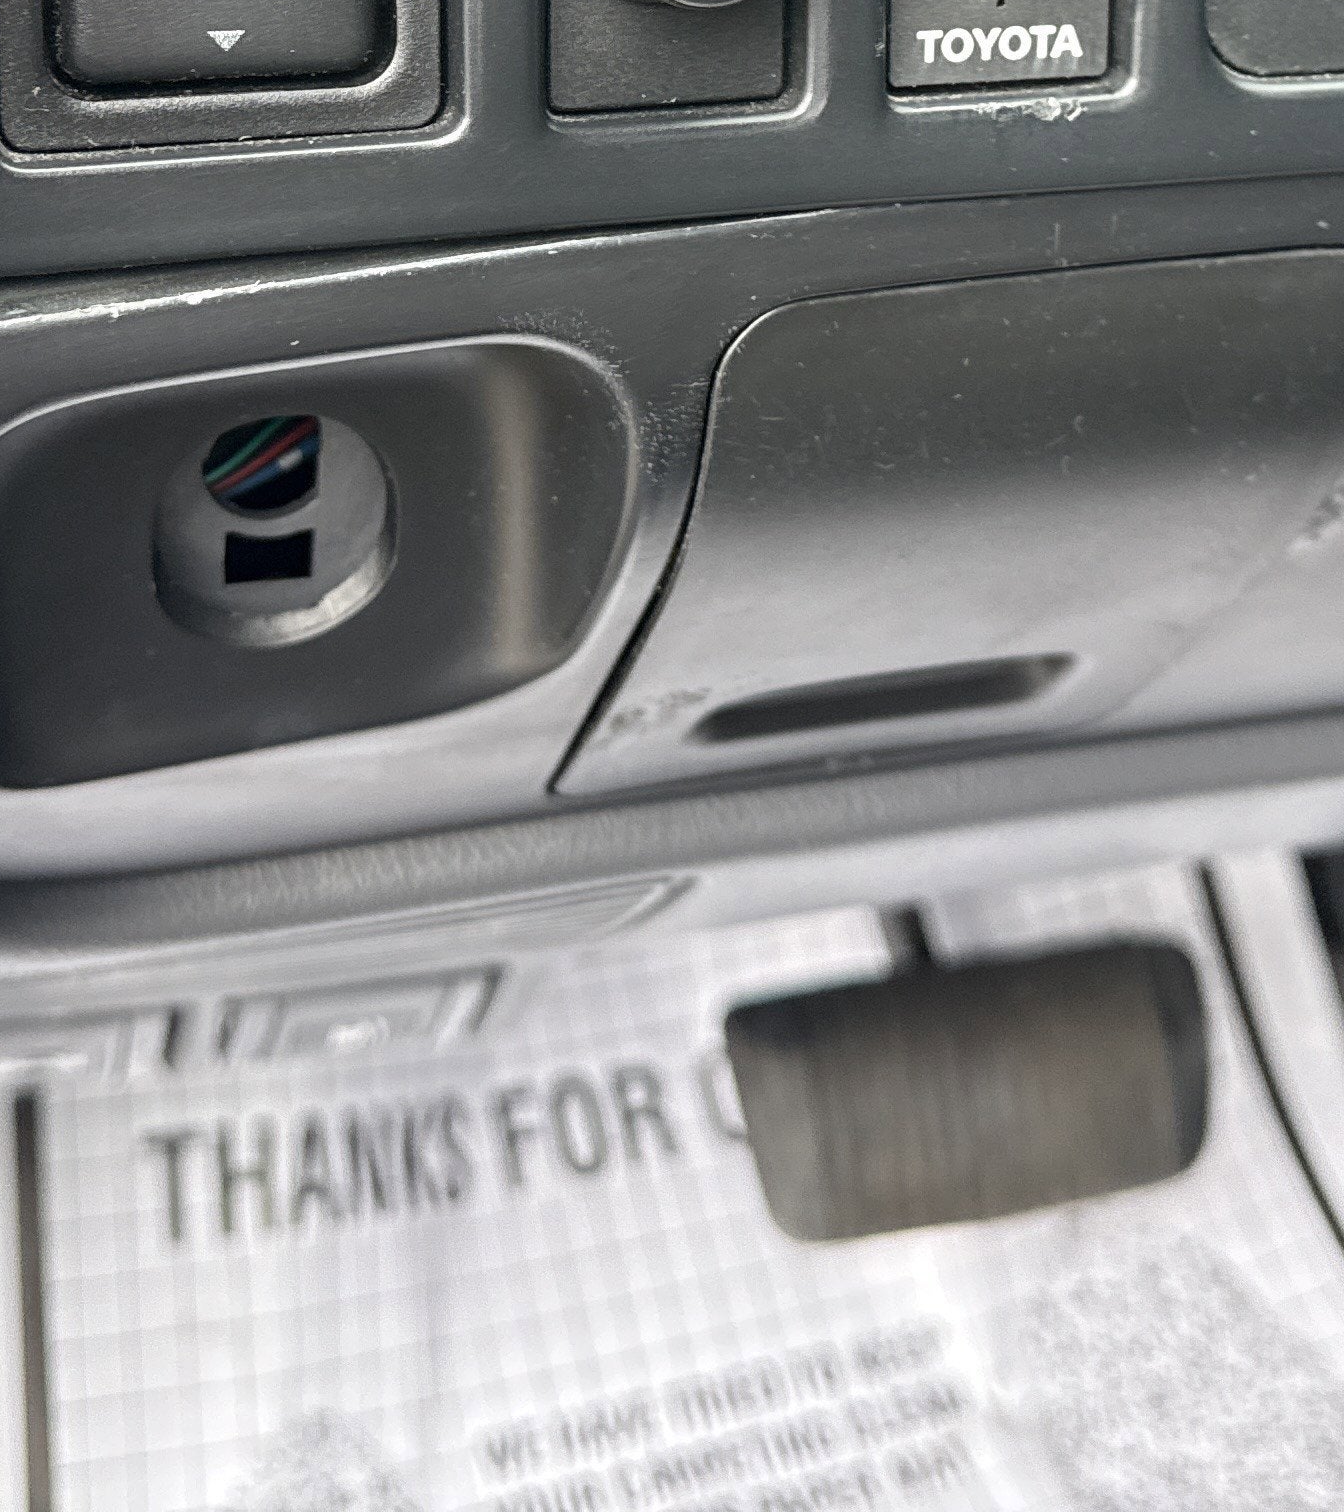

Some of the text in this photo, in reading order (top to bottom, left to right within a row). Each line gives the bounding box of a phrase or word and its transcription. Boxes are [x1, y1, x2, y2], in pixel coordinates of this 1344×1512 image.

[916, 24, 1083, 63] TOYOTA
[140, 1090, 474, 1242] THANKS
[491, 1059, 678, 1186] FOR
